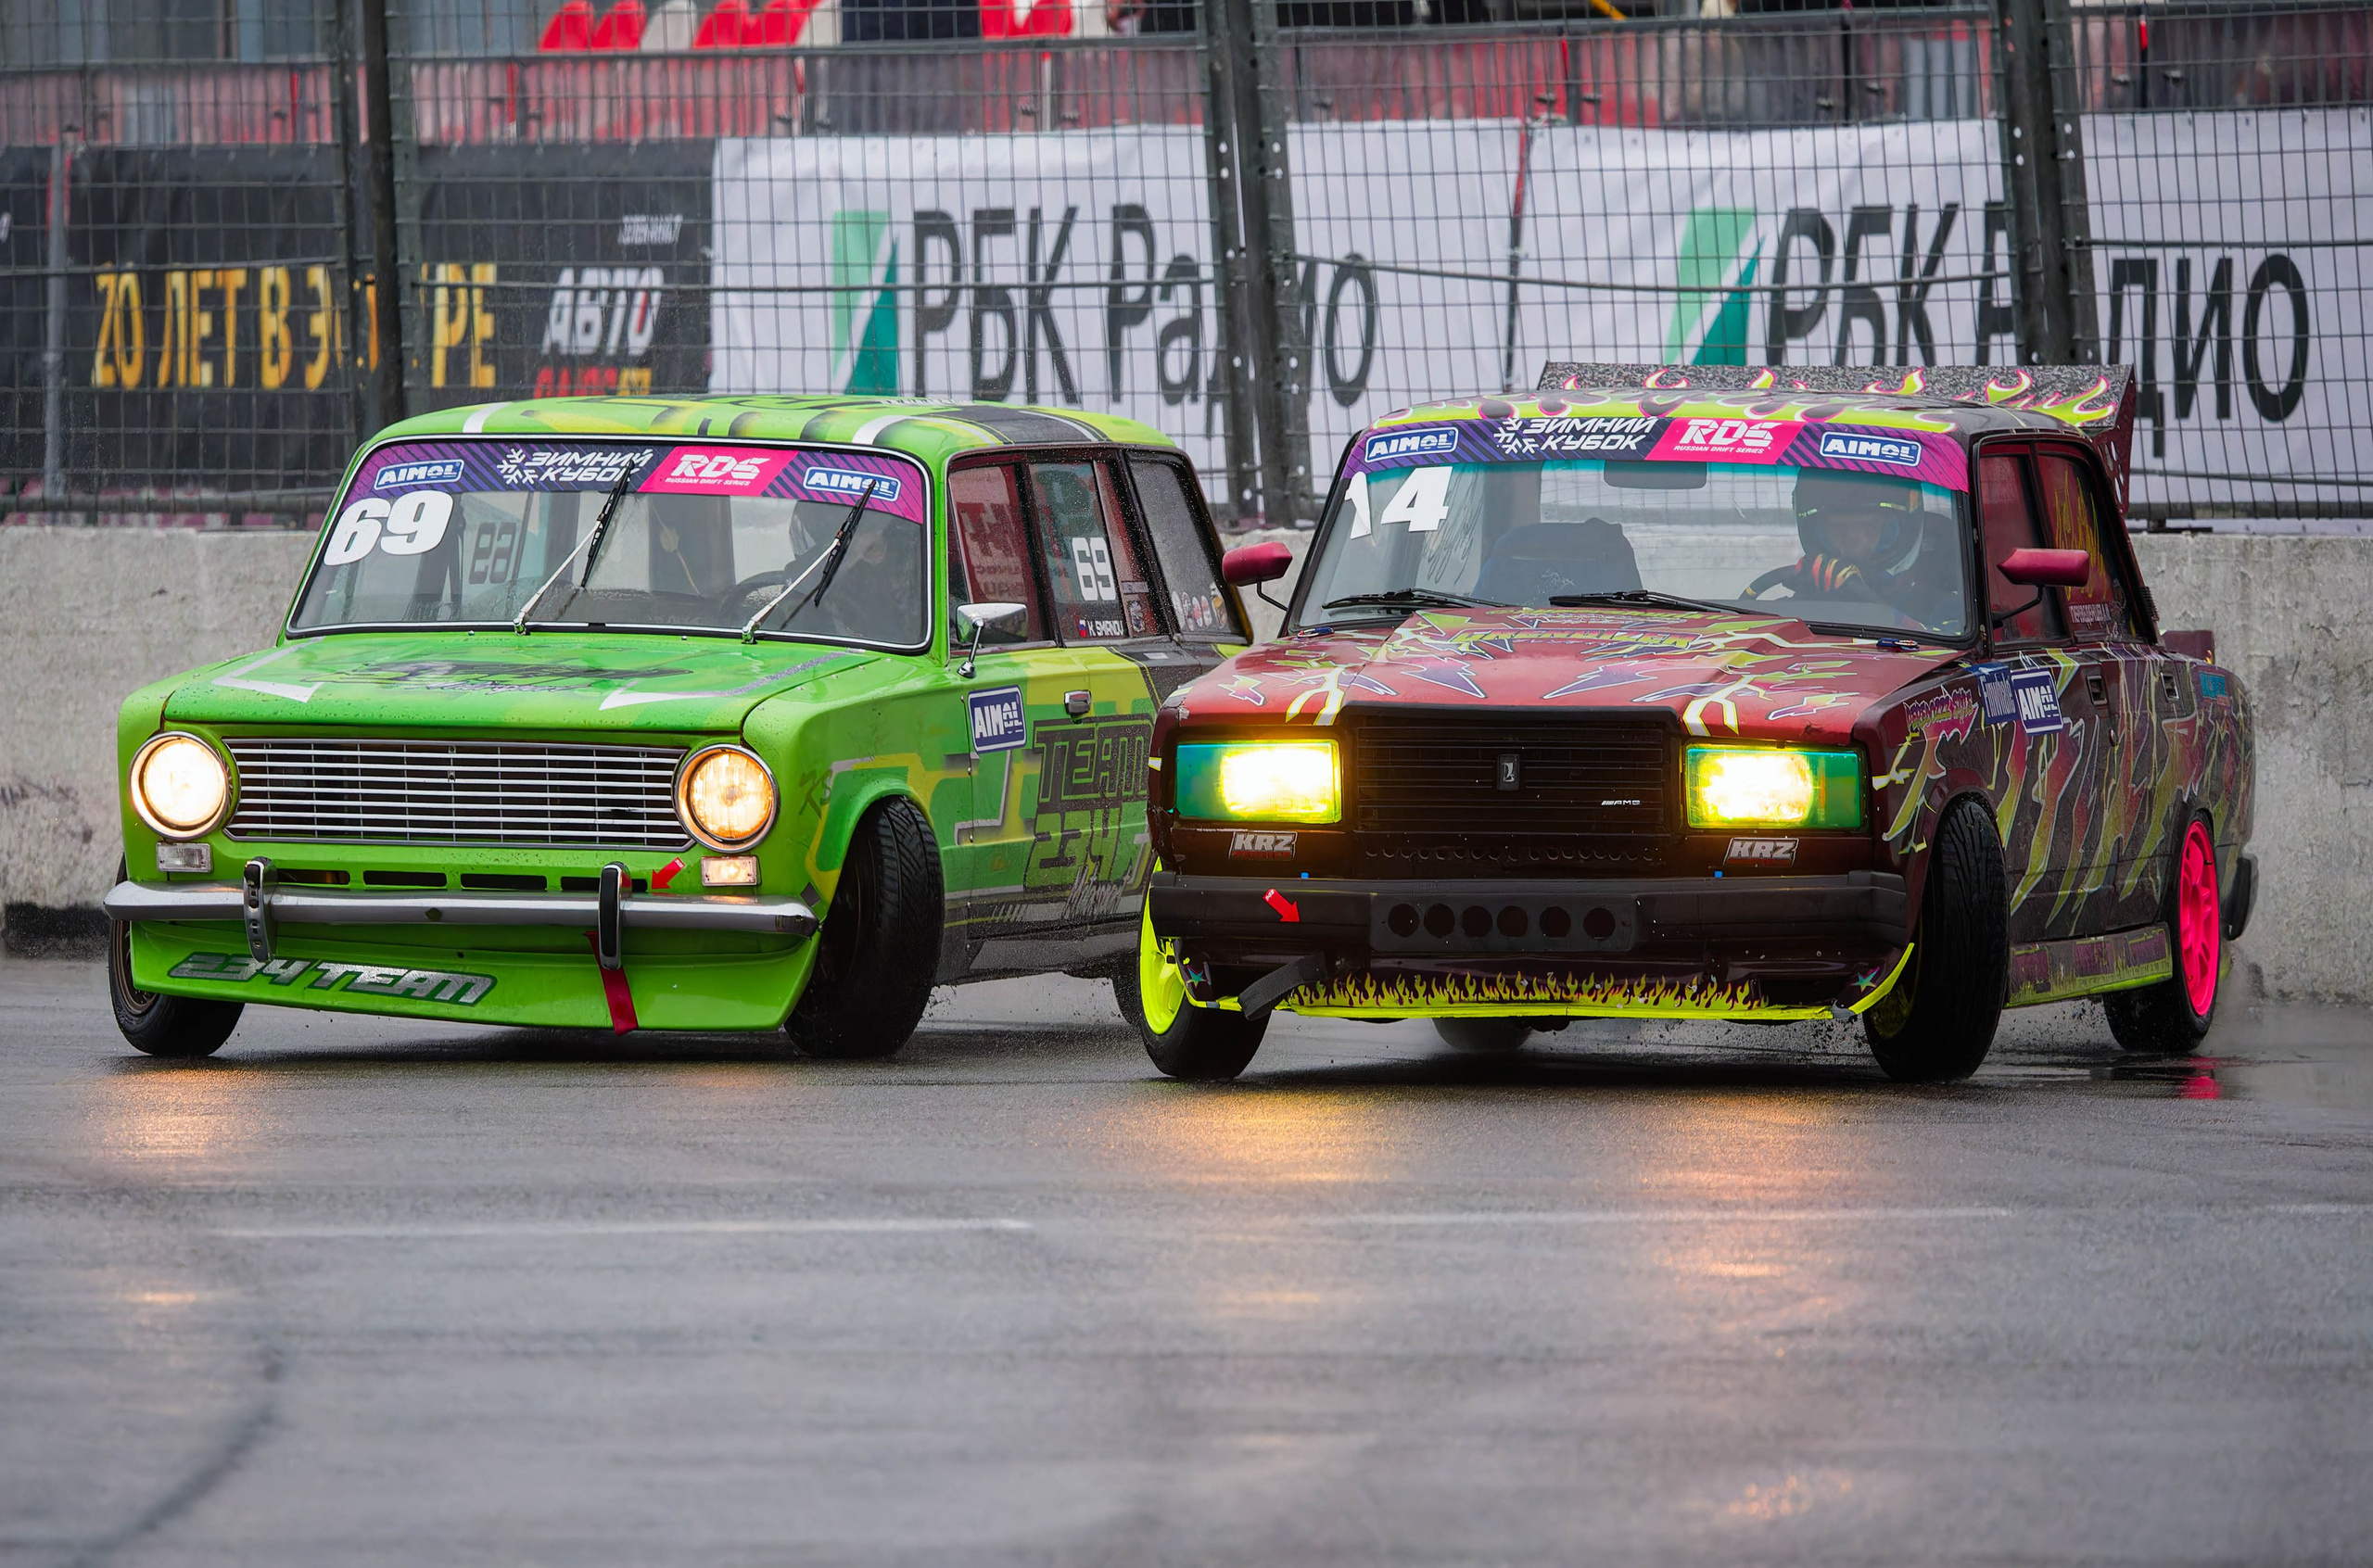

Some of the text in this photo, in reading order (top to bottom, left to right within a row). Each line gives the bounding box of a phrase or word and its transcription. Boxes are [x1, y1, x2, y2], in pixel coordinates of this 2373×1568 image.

[1765, 203, 1960, 367] РБК
[539, 266, 665, 356] АВТО
[913, 205, 1082, 405] РБК
[91, 262, 144, 390] 20
[157, 264, 247, 389] ЛЕТ
[260, 265, 293, 390] В
[1522, 417, 1659, 435] ЗИМНИЙ
[1679, 419, 1783, 448] RDS
[1368, 433, 1453, 458] AIMOL
[1541, 434, 1647, 451] КУБОК
[1823, 438, 1916, 462] AIMOL
[525, 449, 654, 467] ЗИМНИЙ
[670, 454, 770, 480] RDS
[378, 463, 458, 485] AIMOL
[665, 476, 700, 485] RUSSIAN
[700, 478, 723, 487] DRIFT
[807, 471, 895, 496] AIMOL
[1344, 466, 1453, 539] 14
[323, 489, 454, 567] 69
[1072, 537, 1117, 601] 69
[2018, 685, 2059, 721] AIMOL
[974, 701, 1024, 740] AIMOL
[1034, 719, 1152, 803] TEAM
[1234, 833, 1294, 851] KRZ
[1731, 840, 1796, 858] KRZ
[170, 954, 493, 1005] 234 TEAM
